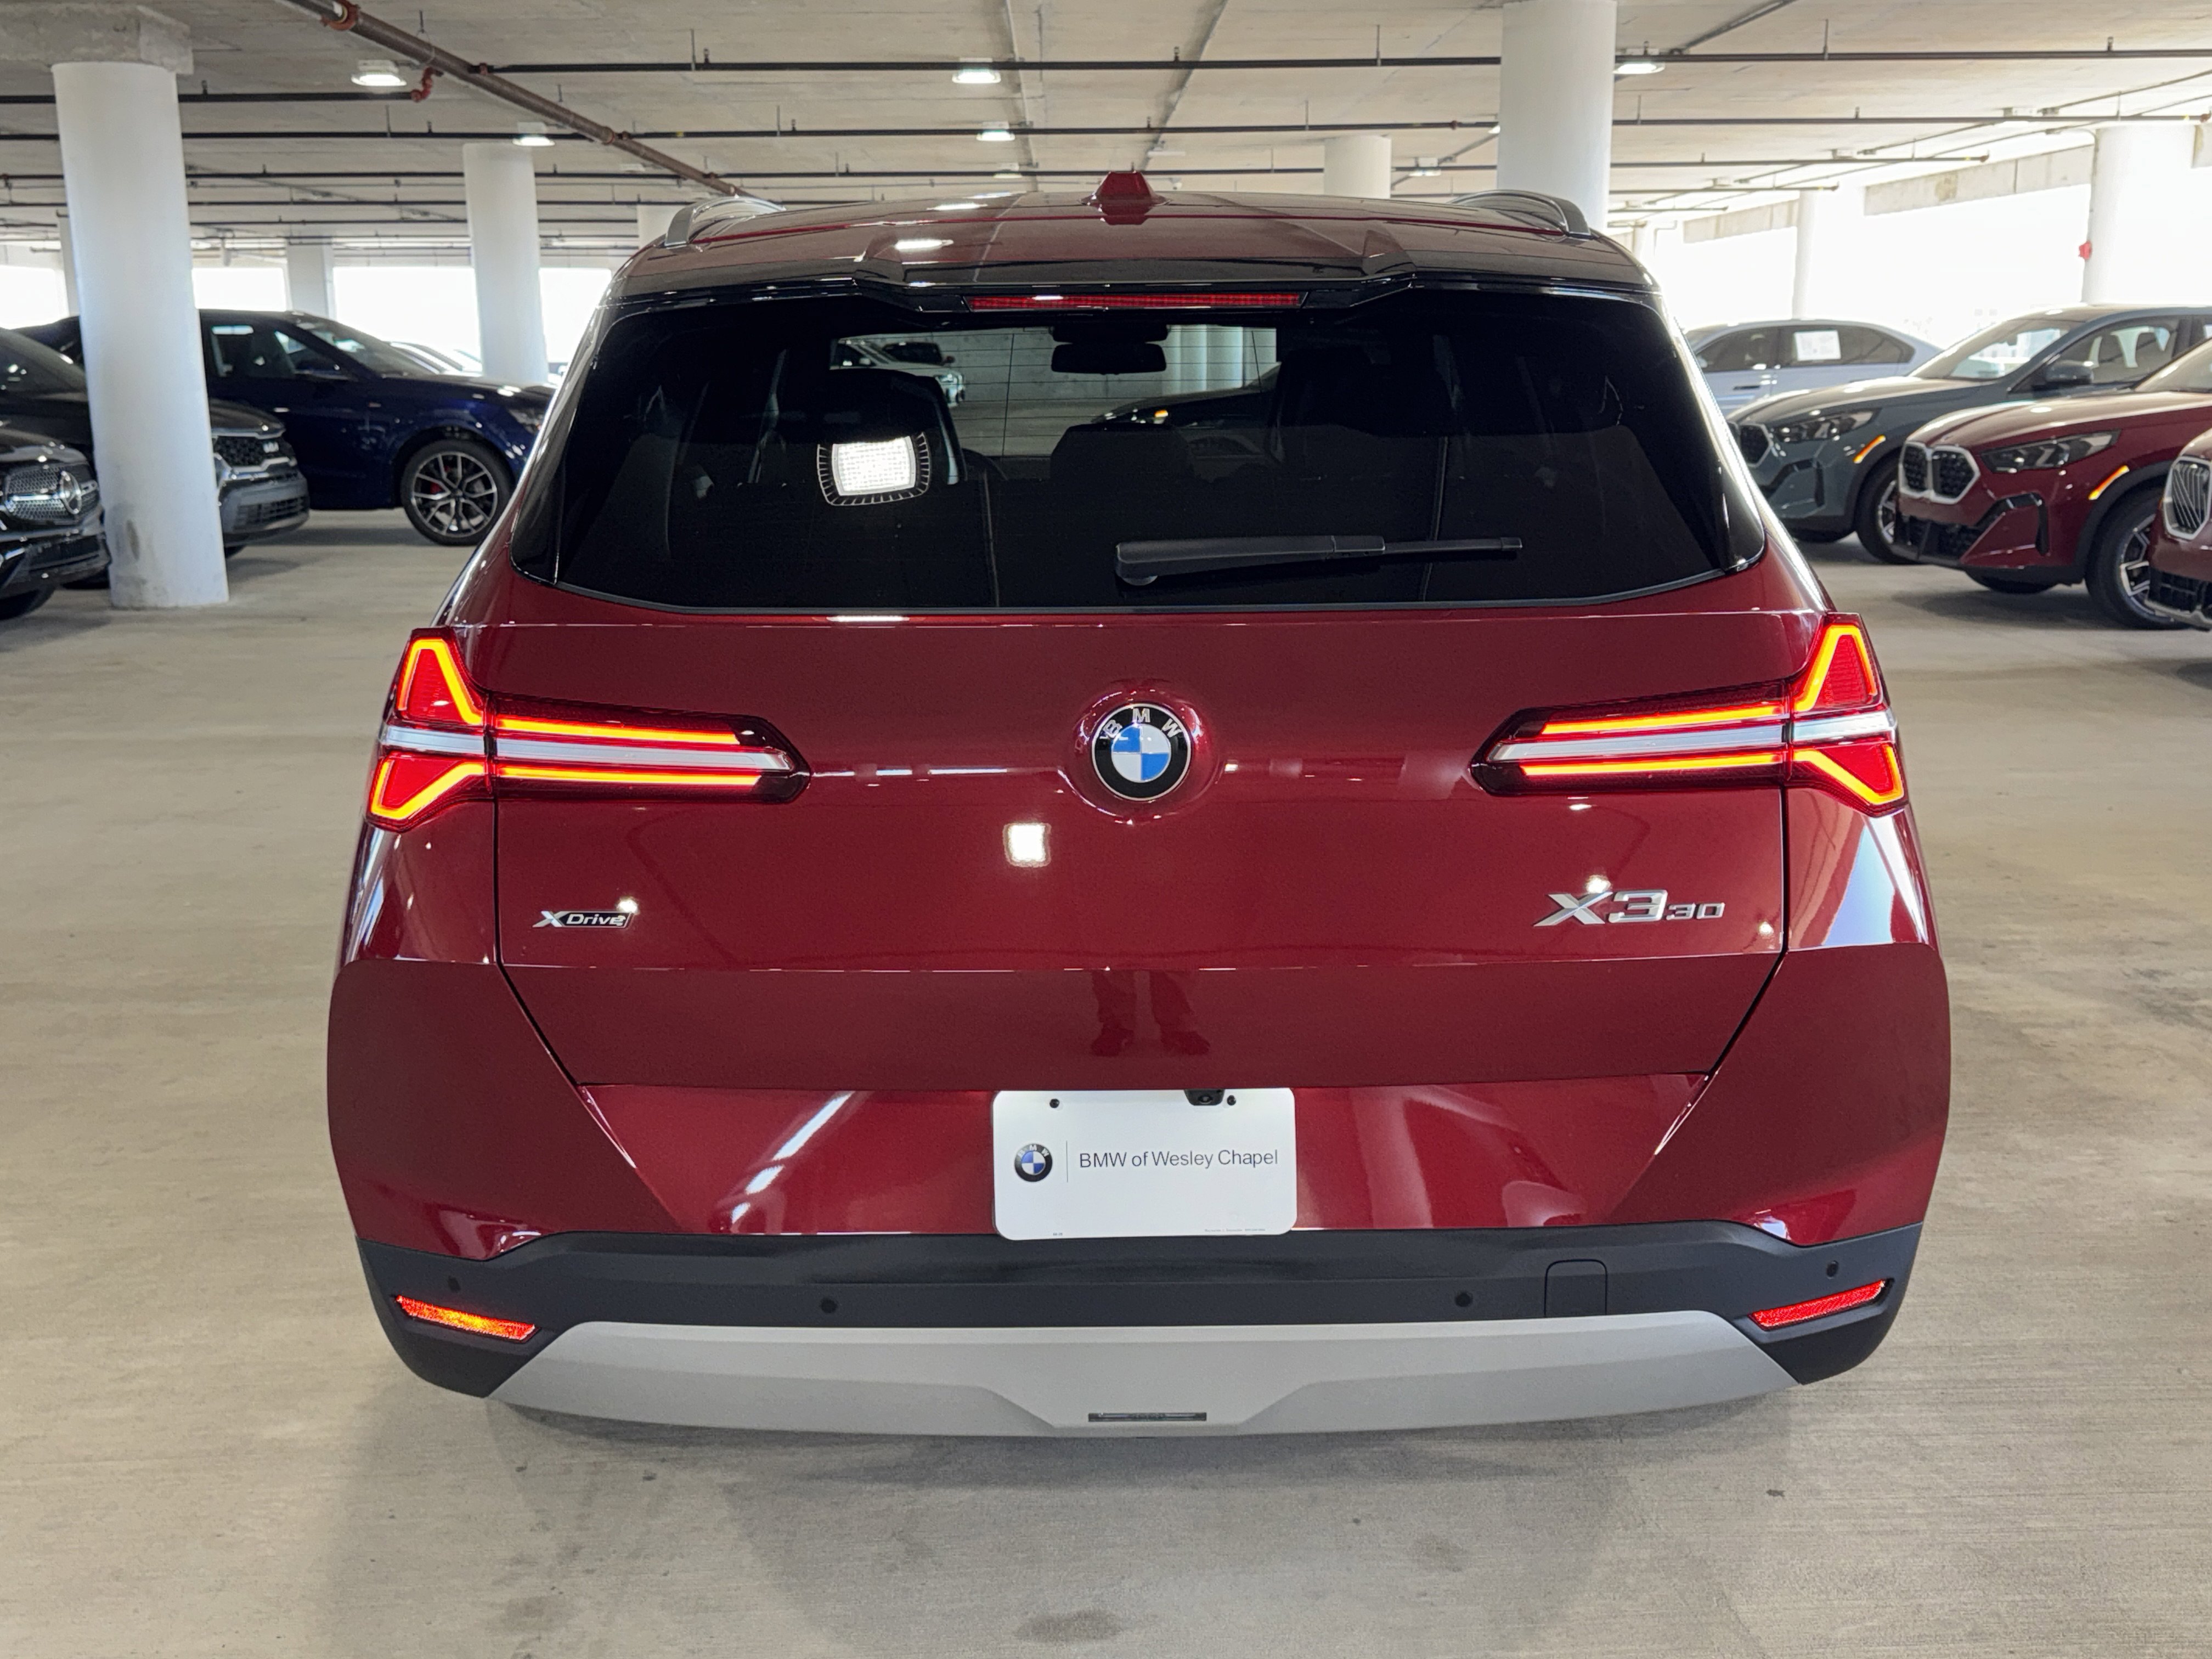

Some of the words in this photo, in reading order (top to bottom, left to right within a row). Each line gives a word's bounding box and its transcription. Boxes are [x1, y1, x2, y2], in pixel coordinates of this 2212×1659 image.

[1102, 708, 1182, 738] BMW
[1080, 1152, 1127, 1168] BMW
[1132, 1152, 1148, 1167] of
[1152, 1150, 1214, 1169] Wesley
[1218, 1149, 1278, 1168] Chapel
